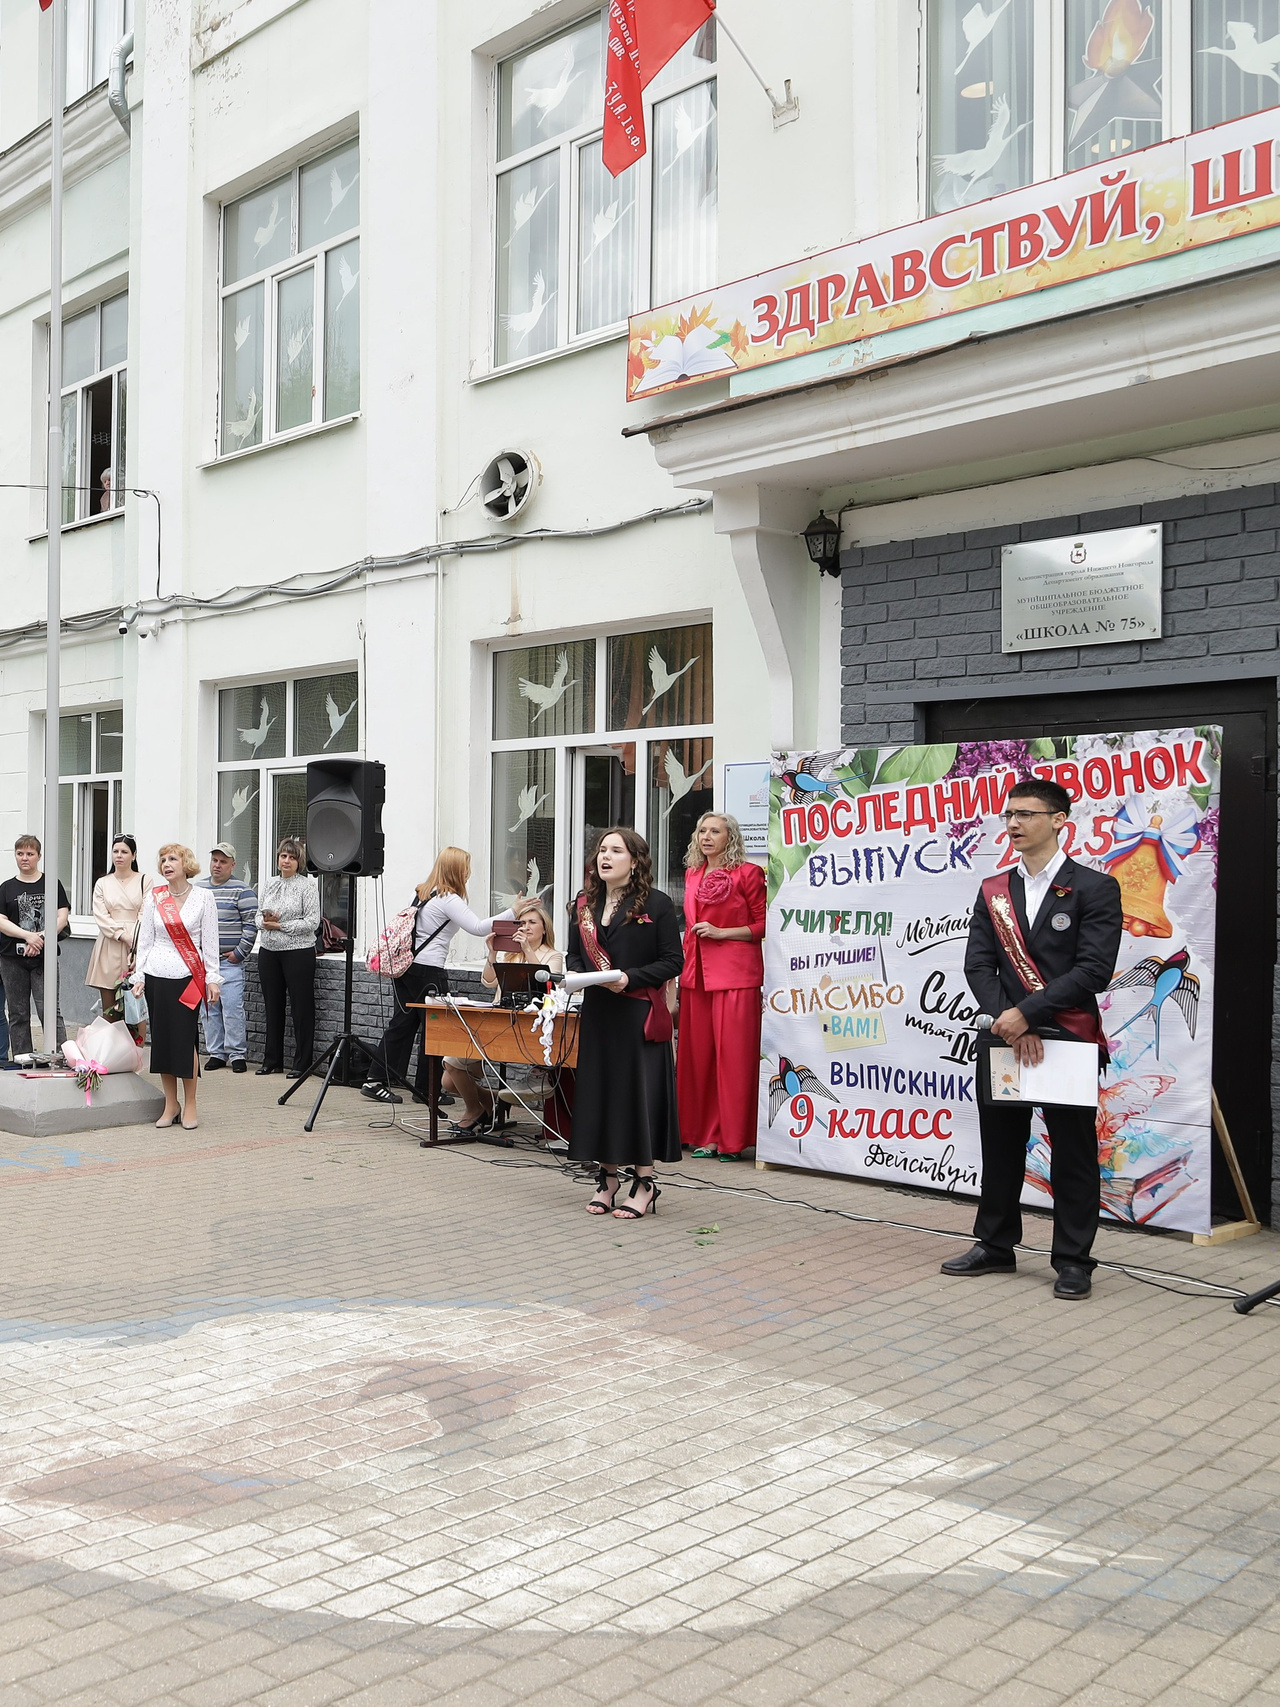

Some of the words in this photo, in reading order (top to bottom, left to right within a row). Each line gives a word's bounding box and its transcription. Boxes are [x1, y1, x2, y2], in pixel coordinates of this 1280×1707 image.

[751, 169, 1165, 348] ЗДРАВСТВУЙ,
[1191, 138, 1280, 217] Ш
[1087, 564, 1117, 574] Нижнего
[1118, 560, 1154, 570] Новгорода
[1017, 591, 1088, 604] МУНИЦИПАЛЬНОЕ
[1089, 583, 1144, 596] БЮДЖЕТНОЕ
[1043, 576, 1083, 586] Департамент
[1030, 594, 1129, 611] ОБЩЕОБРАЗОВАТЕЛЬНОЕ
[1051, 605, 1106, 616] УЧРЕЖДЕНИЕ
[1016, 621, 1090, 641] «ШКОЛА
[1095, 619, 1116, 633] №
[1120, 617, 1146, 631] 75»
[782, 766, 1016, 846] ПОСЛЕДНИЙ
[809, 832, 977, 887] ВЫПУСК
[995, 815, 1118, 869] 225
[780, 908, 893, 936] УЧИТЕЛЯ!
[790, 956, 810, 971] ВЫ
[814, 946, 876, 968] ЛУЧШИЕ!
[770, 983, 905, 1015] СПАСИБО
[831, 1015, 878, 1039] ВАМ!
[905, 1013, 955, 1042] твой
[790, 1094, 814, 1138] 9
[828, 1108, 952, 1140] класс
[865, 1144, 982, 1192] Действуй
